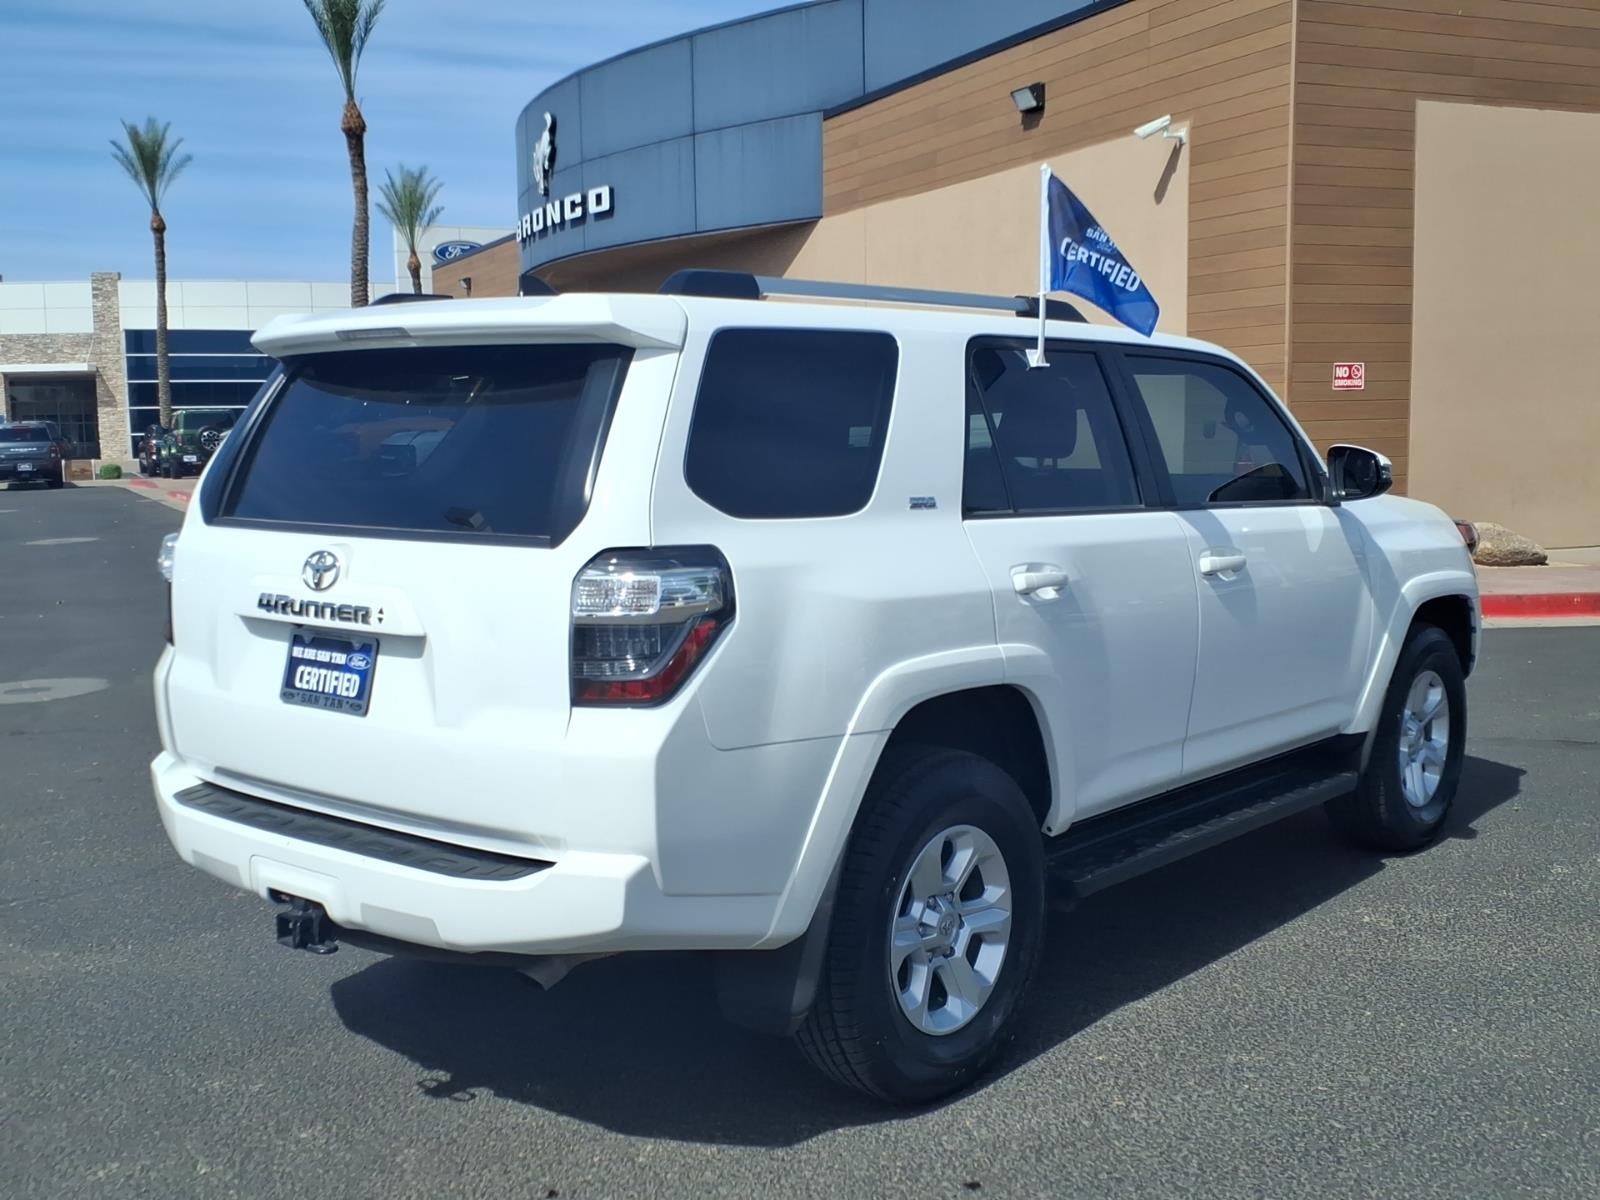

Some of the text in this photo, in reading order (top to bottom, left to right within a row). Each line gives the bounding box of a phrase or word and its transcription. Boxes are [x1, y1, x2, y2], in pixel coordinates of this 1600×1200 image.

[516, 185, 610, 243] BRONCO
[1060, 236, 1141, 292] CERTIFIED
[1336, 366, 1349, 378] NO
[295, 665, 360, 698] CERTIFIED
[301, 692, 320, 706] SAN
[324, 696, 344, 709] TAN
